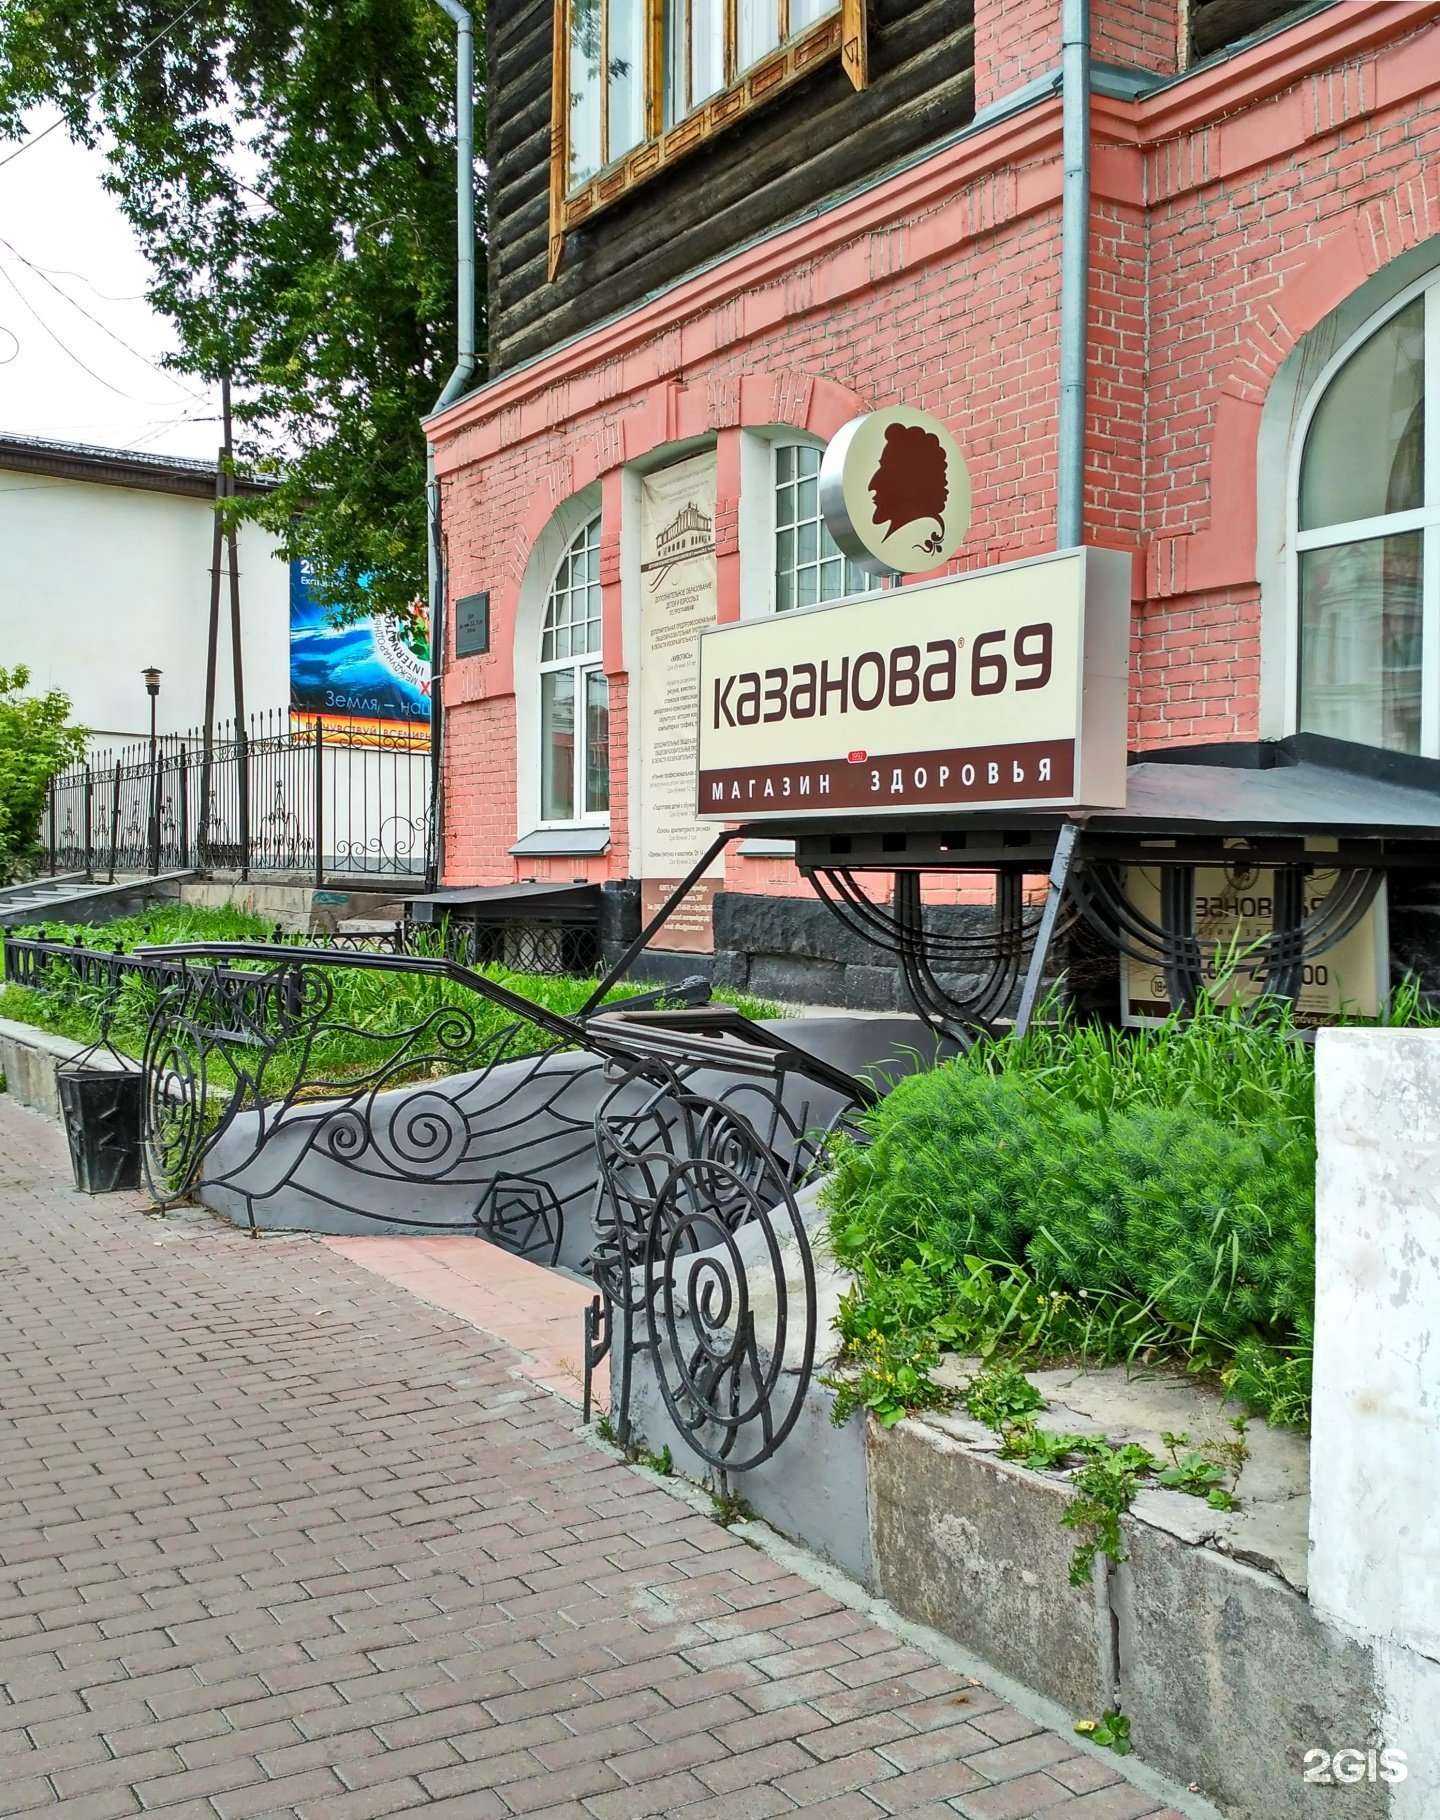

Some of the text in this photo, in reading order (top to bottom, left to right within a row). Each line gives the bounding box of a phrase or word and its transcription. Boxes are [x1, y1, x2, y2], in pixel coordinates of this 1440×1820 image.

[971, 622, 1053, 697] 69
[383, 728, 431, 739] ВСЕМИРН
[712, 757, 1052, 801] МАГАЗИН ЗДОРОВЬЯ
